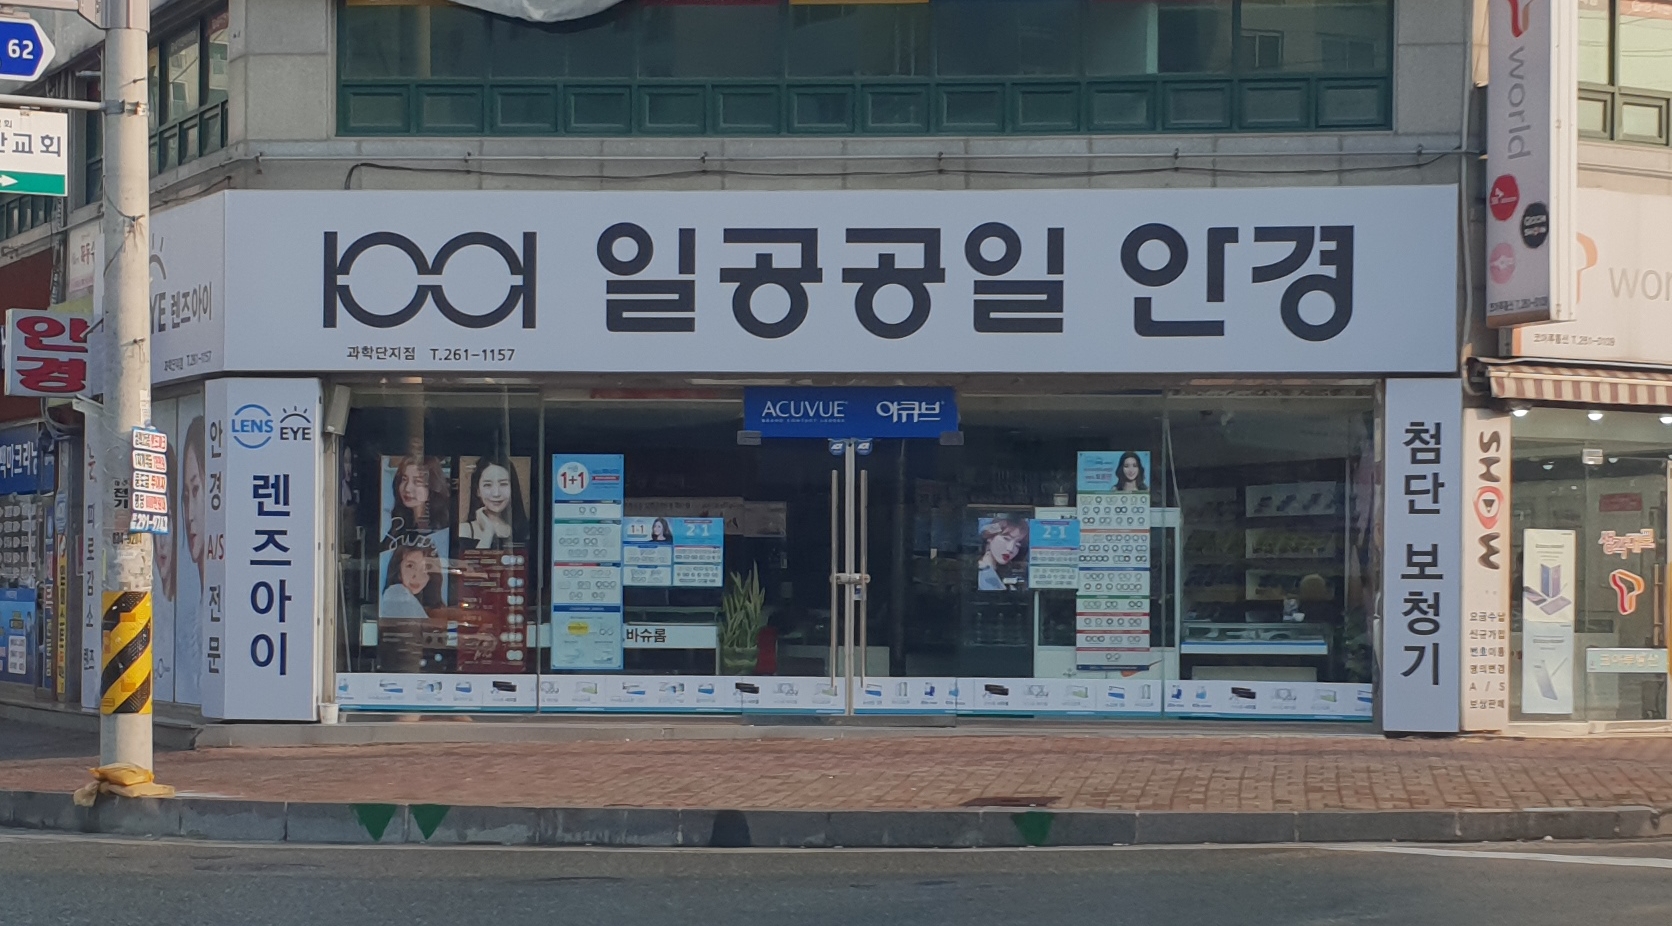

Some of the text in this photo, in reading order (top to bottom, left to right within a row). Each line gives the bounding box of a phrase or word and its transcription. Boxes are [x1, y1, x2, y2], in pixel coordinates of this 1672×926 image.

[8, 39, 34, 59] 62
[1507, 46, 1531, 160] world
[597, 221, 1354, 342] 일공공일 안경
[347, 346, 516, 361] 과학단지점 T.261-1157
[762, 401, 845, 417] ACUVUE
[876, 401, 941, 423] 아큐브
[231, 419, 272, 433] LENS
[280, 427, 311, 441] EYE
[210, 420, 223, 511] 안경
[561, 471, 584, 489] 1+1
[1400, 421, 1445, 686] 첨단 보청기
[250, 474, 292, 676] 렌즈아이
[207, 585, 221, 674] 전문
[626, 628, 667, 644] 바슈롬
